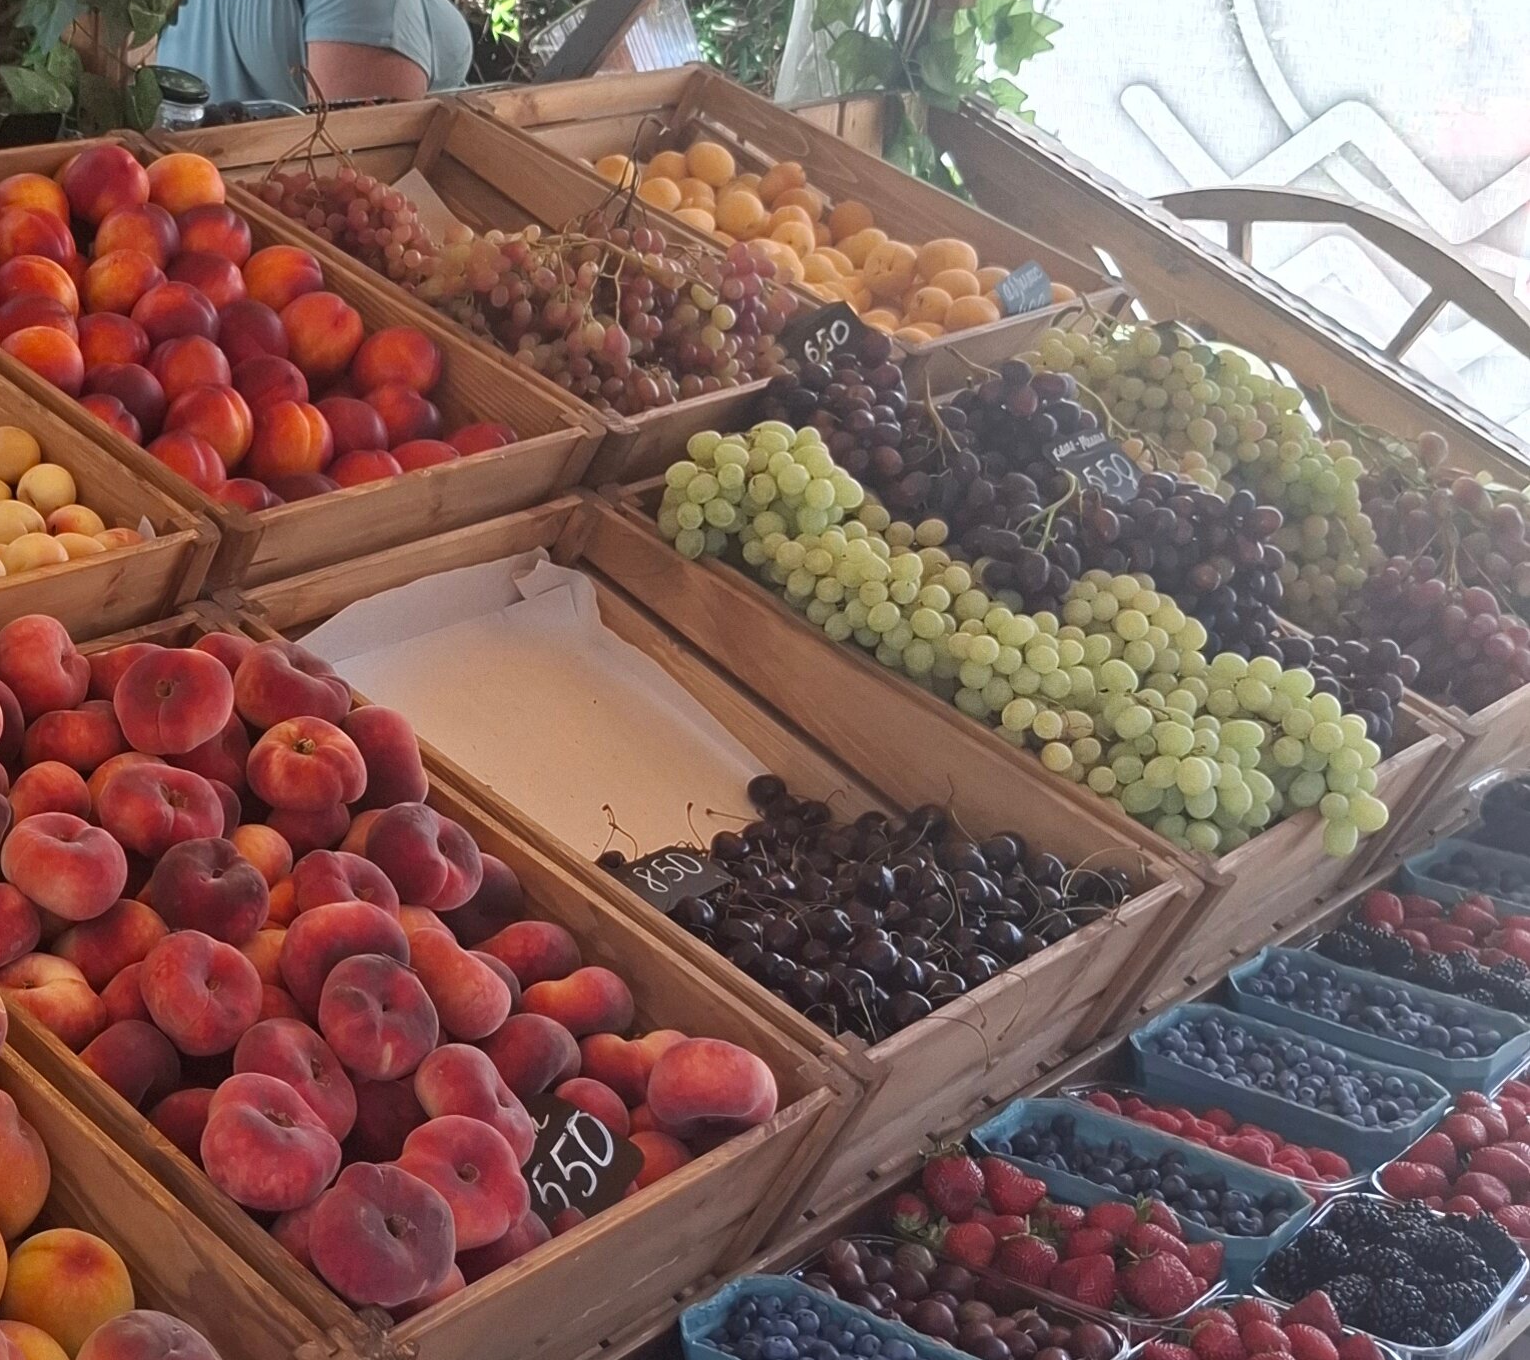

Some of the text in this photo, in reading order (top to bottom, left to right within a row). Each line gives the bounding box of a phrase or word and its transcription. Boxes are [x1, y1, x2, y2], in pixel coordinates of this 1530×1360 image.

[804, 319, 850, 364] 650
[1082, 452, 1139, 495] 550
[632, 852, 703, 893] 850
[532, 1109, 614, 1209] 550
